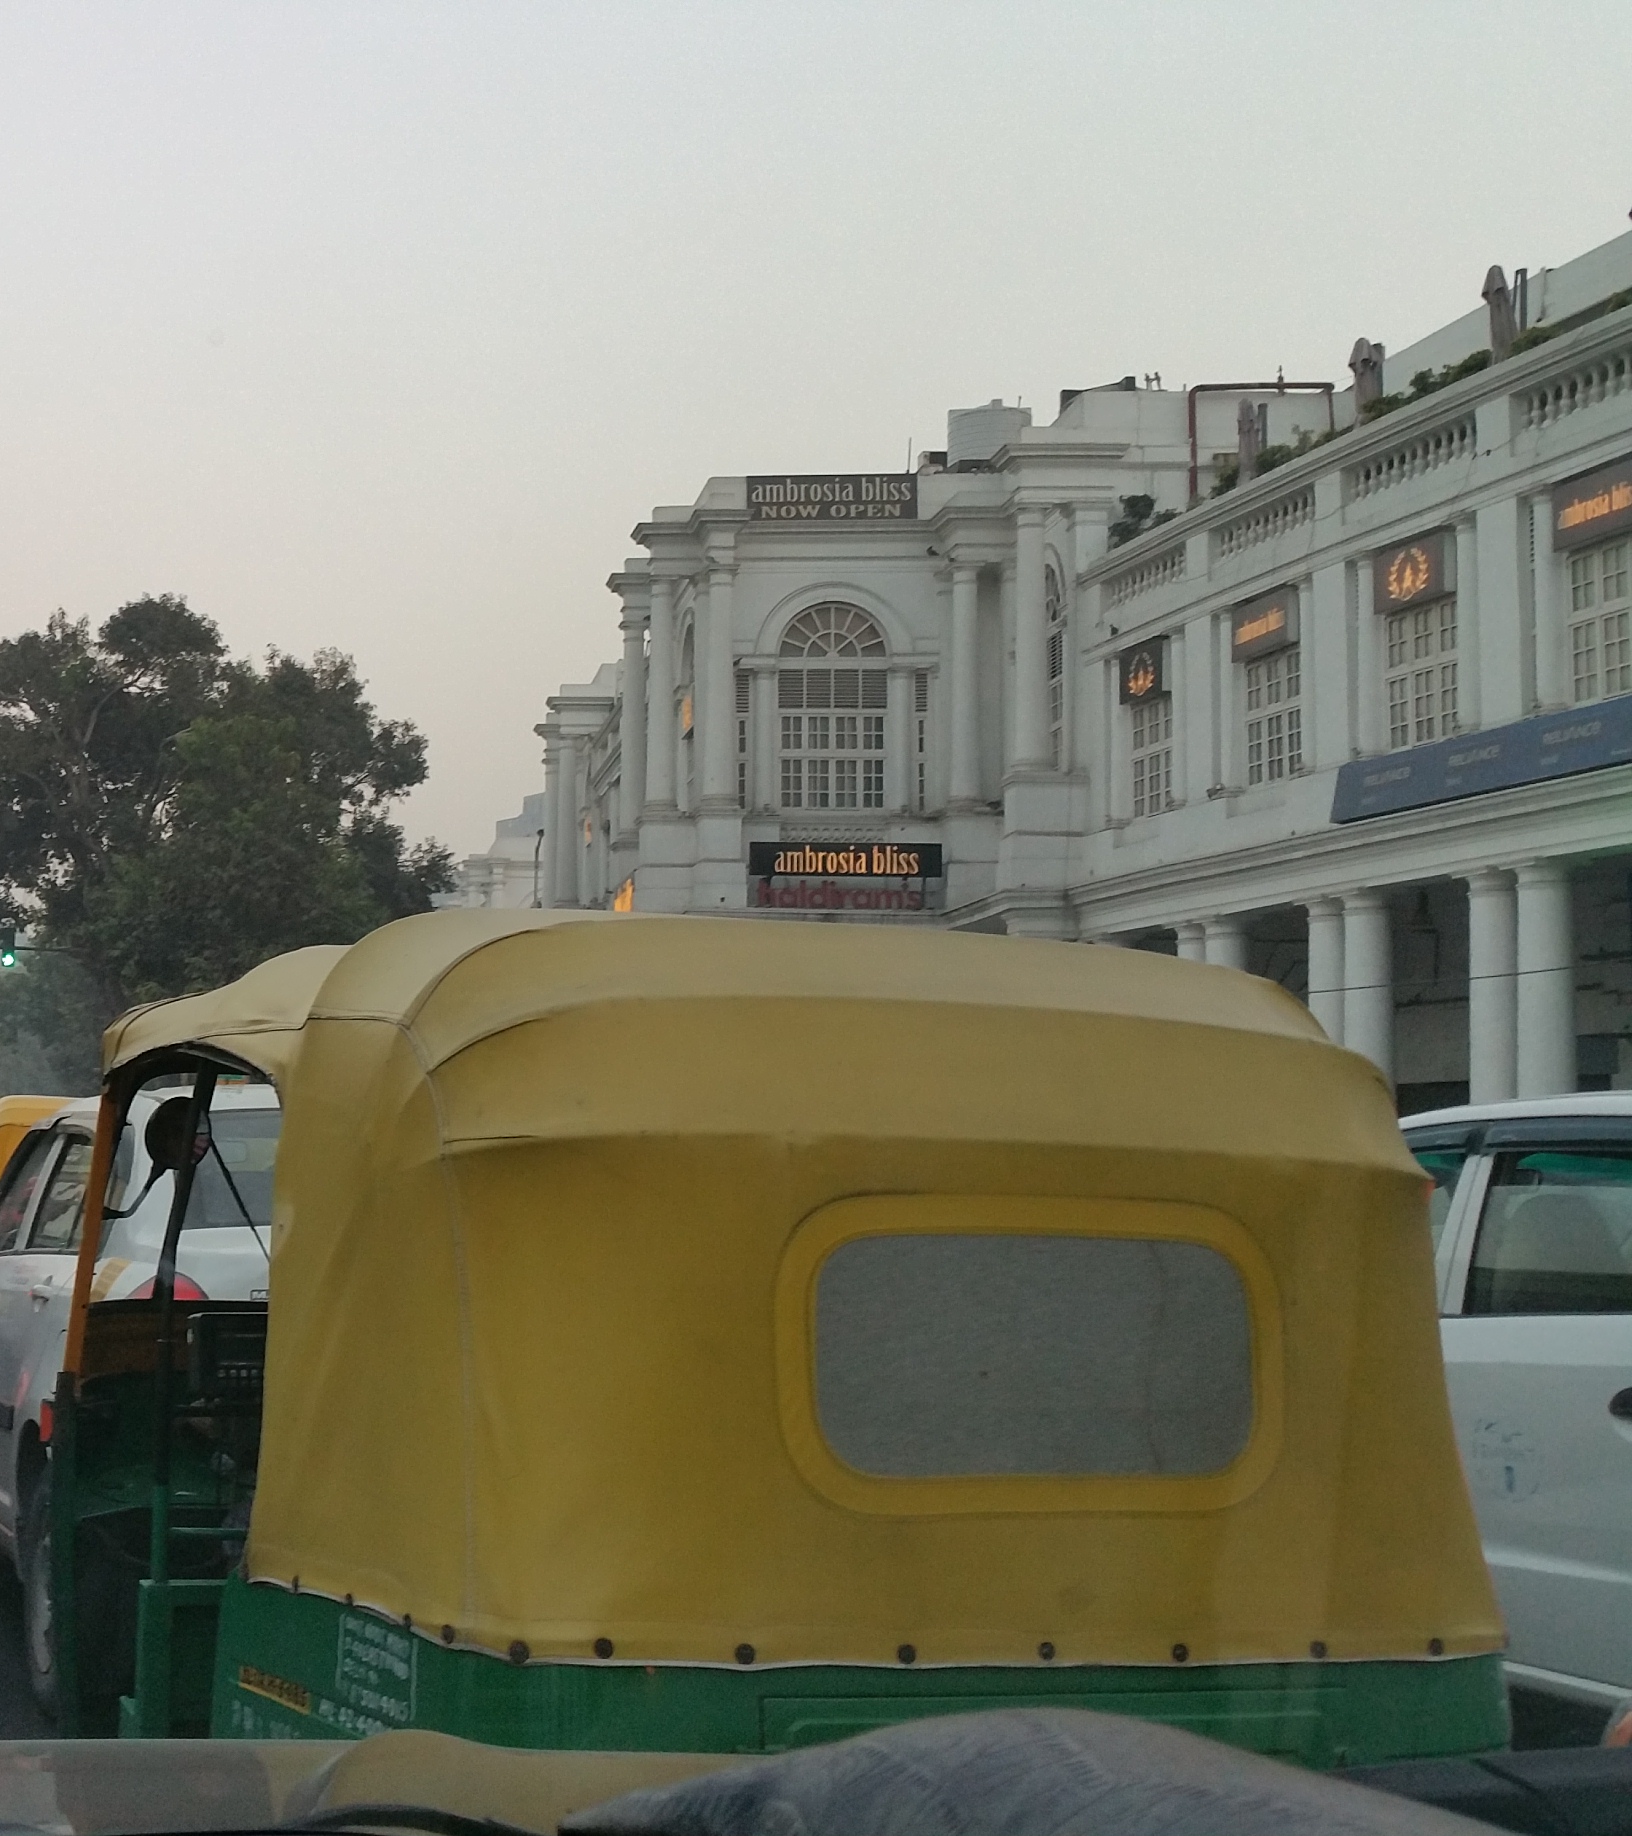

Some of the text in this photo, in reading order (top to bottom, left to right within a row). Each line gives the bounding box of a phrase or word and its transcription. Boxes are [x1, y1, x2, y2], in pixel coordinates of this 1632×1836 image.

[751, 477, 912, 503] ambrosia bliss
[761, 504, 902, 519] NOW OPEN
[774, 845, 920, 875] ambrosia bliss
